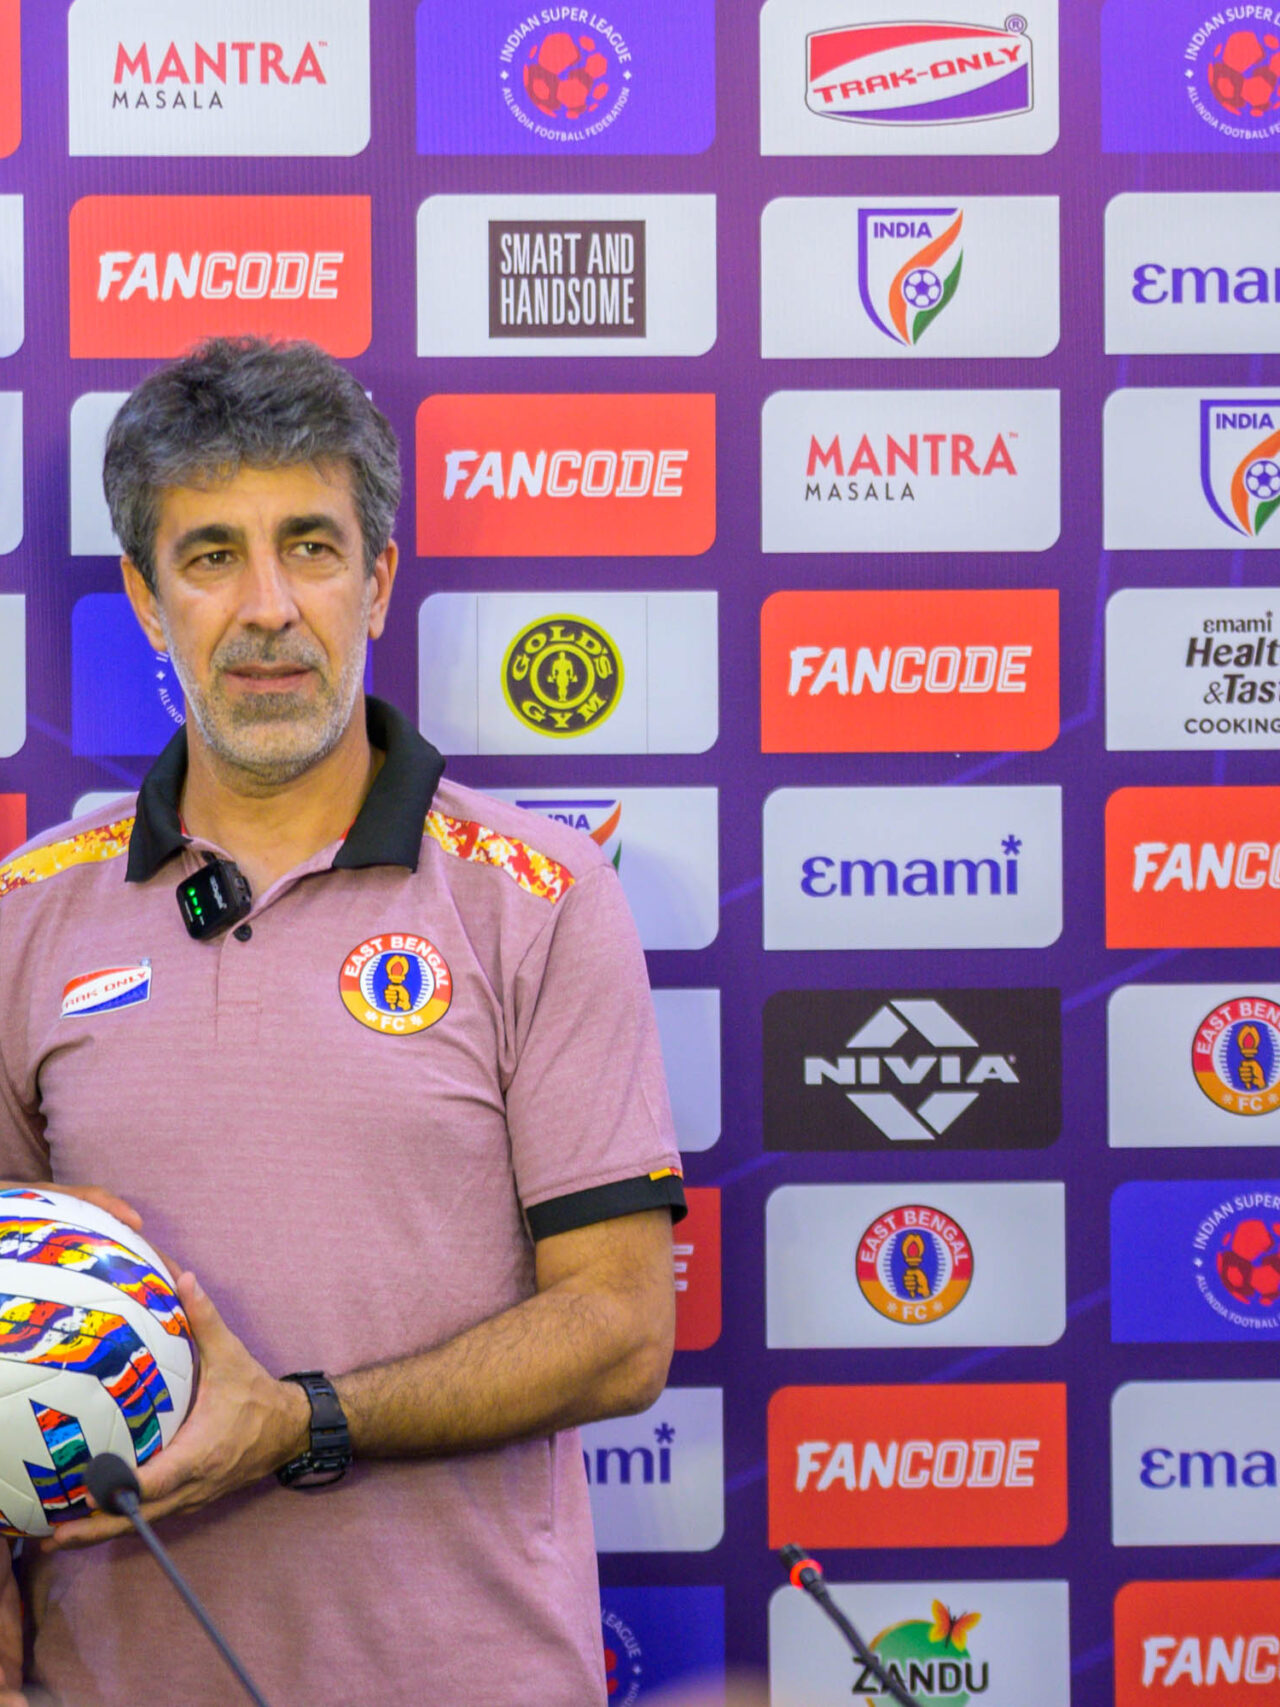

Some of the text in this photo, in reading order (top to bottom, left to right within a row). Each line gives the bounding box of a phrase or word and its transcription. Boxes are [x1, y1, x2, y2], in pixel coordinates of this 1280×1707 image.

[499, 6, 632, 64] INDIAN SUPER LEAGUE
[1184, 13, 1225, 61] INDIAN
[1226, 5, 1273, 22] SUPER
[113, 41, 327, 85] MANTRA
[813, 44, 1021, 104] TRAK-ONLY
[112, 91, 223, 109] MASALA
[502, 86, 630, 142] ALL INDIA FOOTBALL FEDERATION
[1187, 86, 1199, 104] ALL
[1195, 102, 1219, 128] INDIA
[1219, 123, 1269, 140] FOOTBALL
[873, 222, 932, 239] INDIA
[97, 250, 344, 302] FANCODE
[500, 232, 635, 275] SMART AND
[500, 279, 635, 325] HANDSOME
[1131, 262, 1280, 304] ema
[1216, 413, 1274, 430] INDIA
[443, 449, 688, 500] FANCODE
[806, 433, 1018, 476] MANTRA
[805, 484, 915, 502] MASALA
[512, 625, 613, 681] GOLD'S
[787, 646, 1032, 696] FANCODE
[1185, 636, 1280, 667] Healt
[521, 692, 607, 728] GYM
[1203, 674, 1280, 705] &Tas
[1133, 842, 1280, 892] FANC
[344, 936, 449, 989] EAST BENGAL
[380, 1015, 405, 1031] FC
[1196, 1006, 1234, 1055] EAST
[805, 1056, 1019, 1085] NIVIA
[1237, 1097, 1263, 1112] FC
[861, 1210, 968, 1266] EAST BENGAL
[1193, 1202, 1234, 1250] INDIAN
[902, 1304, 927, 1320] FC
[1228, 1313, 1280, 1329] FOOTBALL
[796, 1439, 1040, 1492] FANCODE
[1140, 1448, 1278, 1490] ema
[1142, 1635, 1280, 1688] FANC
